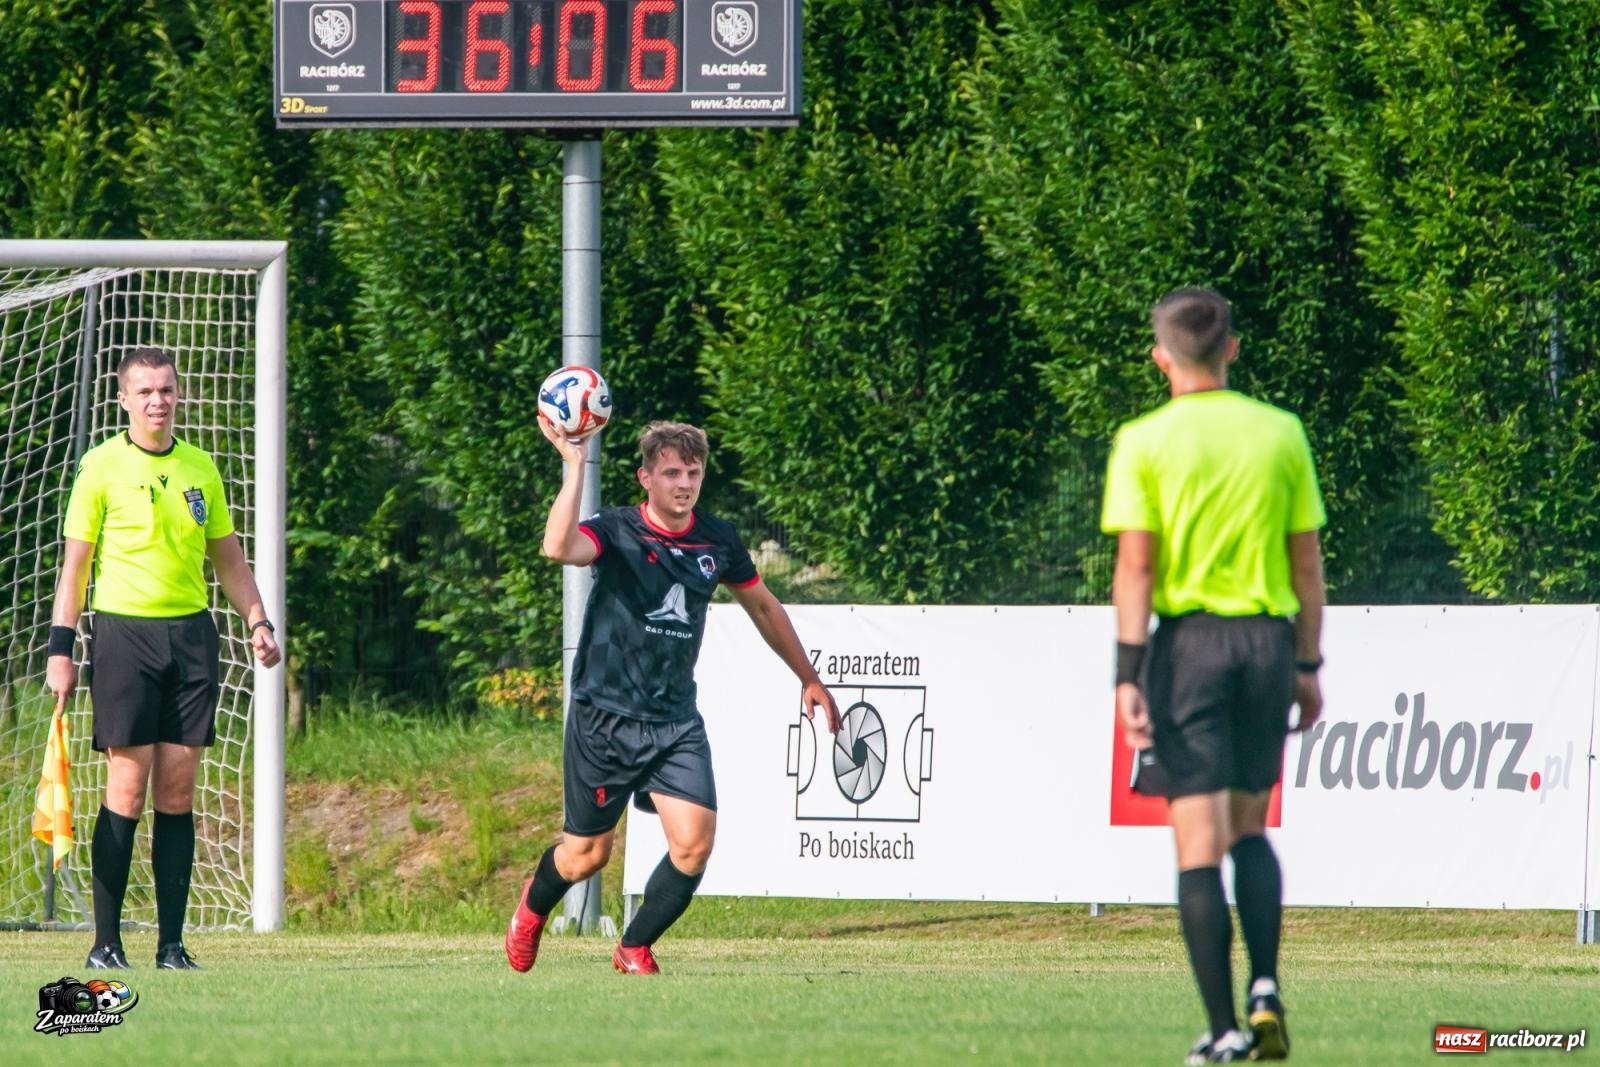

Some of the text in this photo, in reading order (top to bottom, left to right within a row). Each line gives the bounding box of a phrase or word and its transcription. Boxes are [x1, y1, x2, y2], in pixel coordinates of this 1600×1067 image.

[397, 0, 678, 92] 36:06
[299, 62, 366, 78] RACIBÓRZ
[701, 60, 767, 76] RACIBÓRZ
[280, 97, 305, 113] 3D
[690, 96, 786, 111] www.3d.com.pl
[665, 629, 693, 639] GROUP
[808, 649, 921, 683] Z aparatem
[799, 831, 915, 860] Po boiskach
